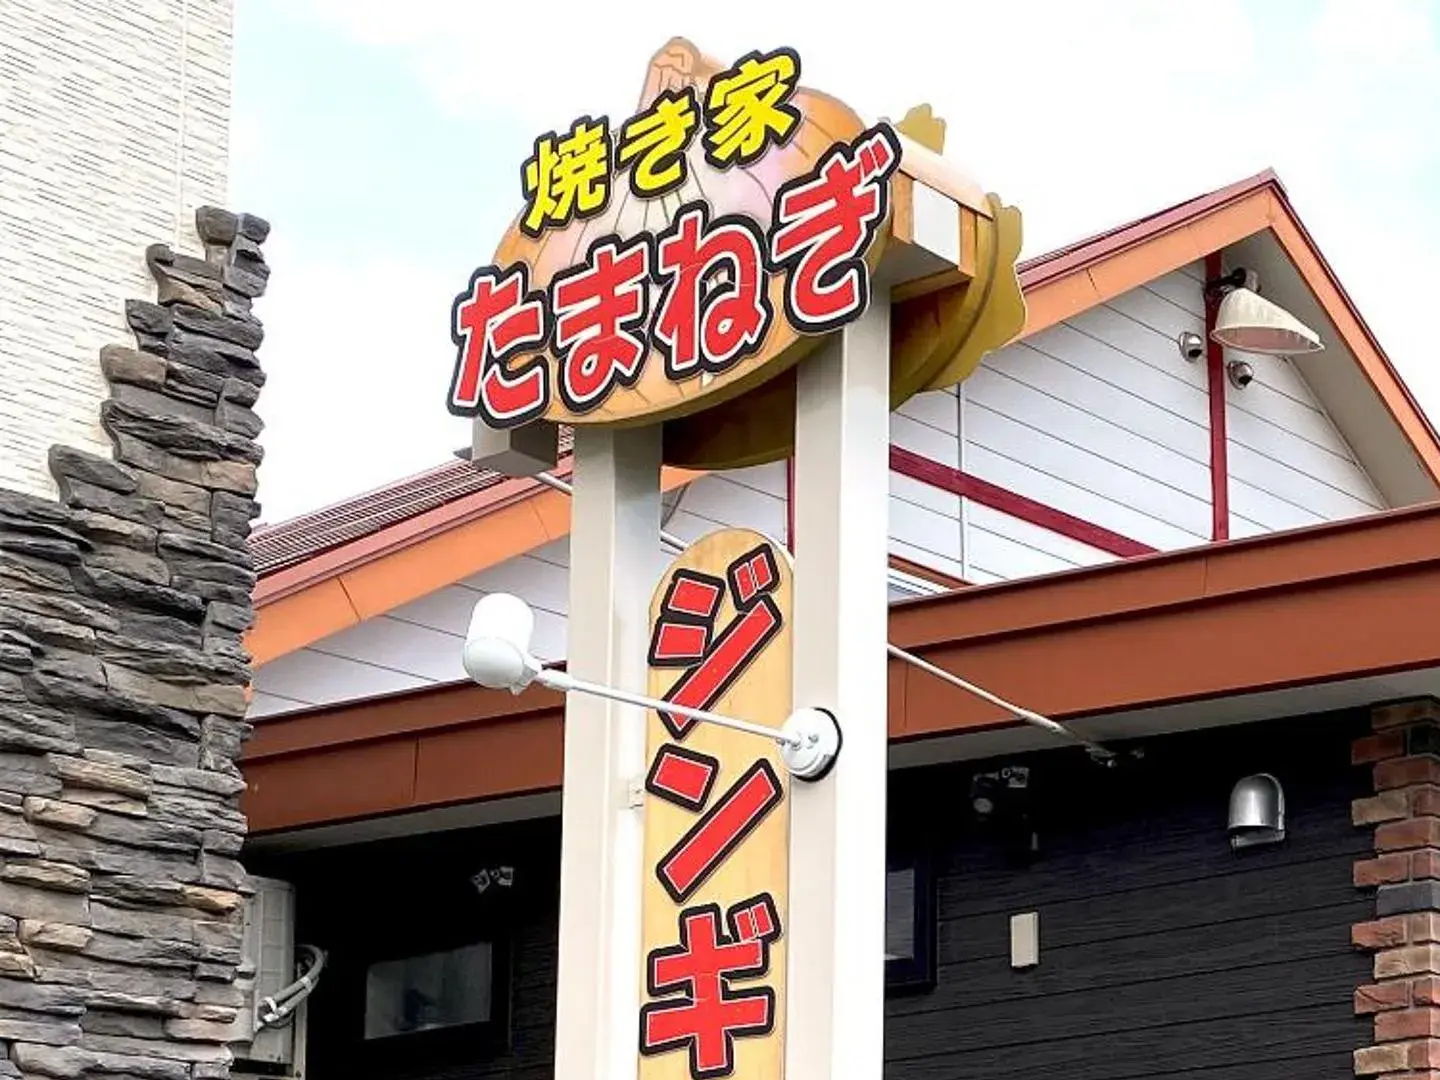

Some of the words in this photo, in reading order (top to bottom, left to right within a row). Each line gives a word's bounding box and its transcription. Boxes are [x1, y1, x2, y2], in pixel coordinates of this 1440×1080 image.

[521, 48, 800, 235] 焼き家
[448, 123, 900, 425] たまねぎ
